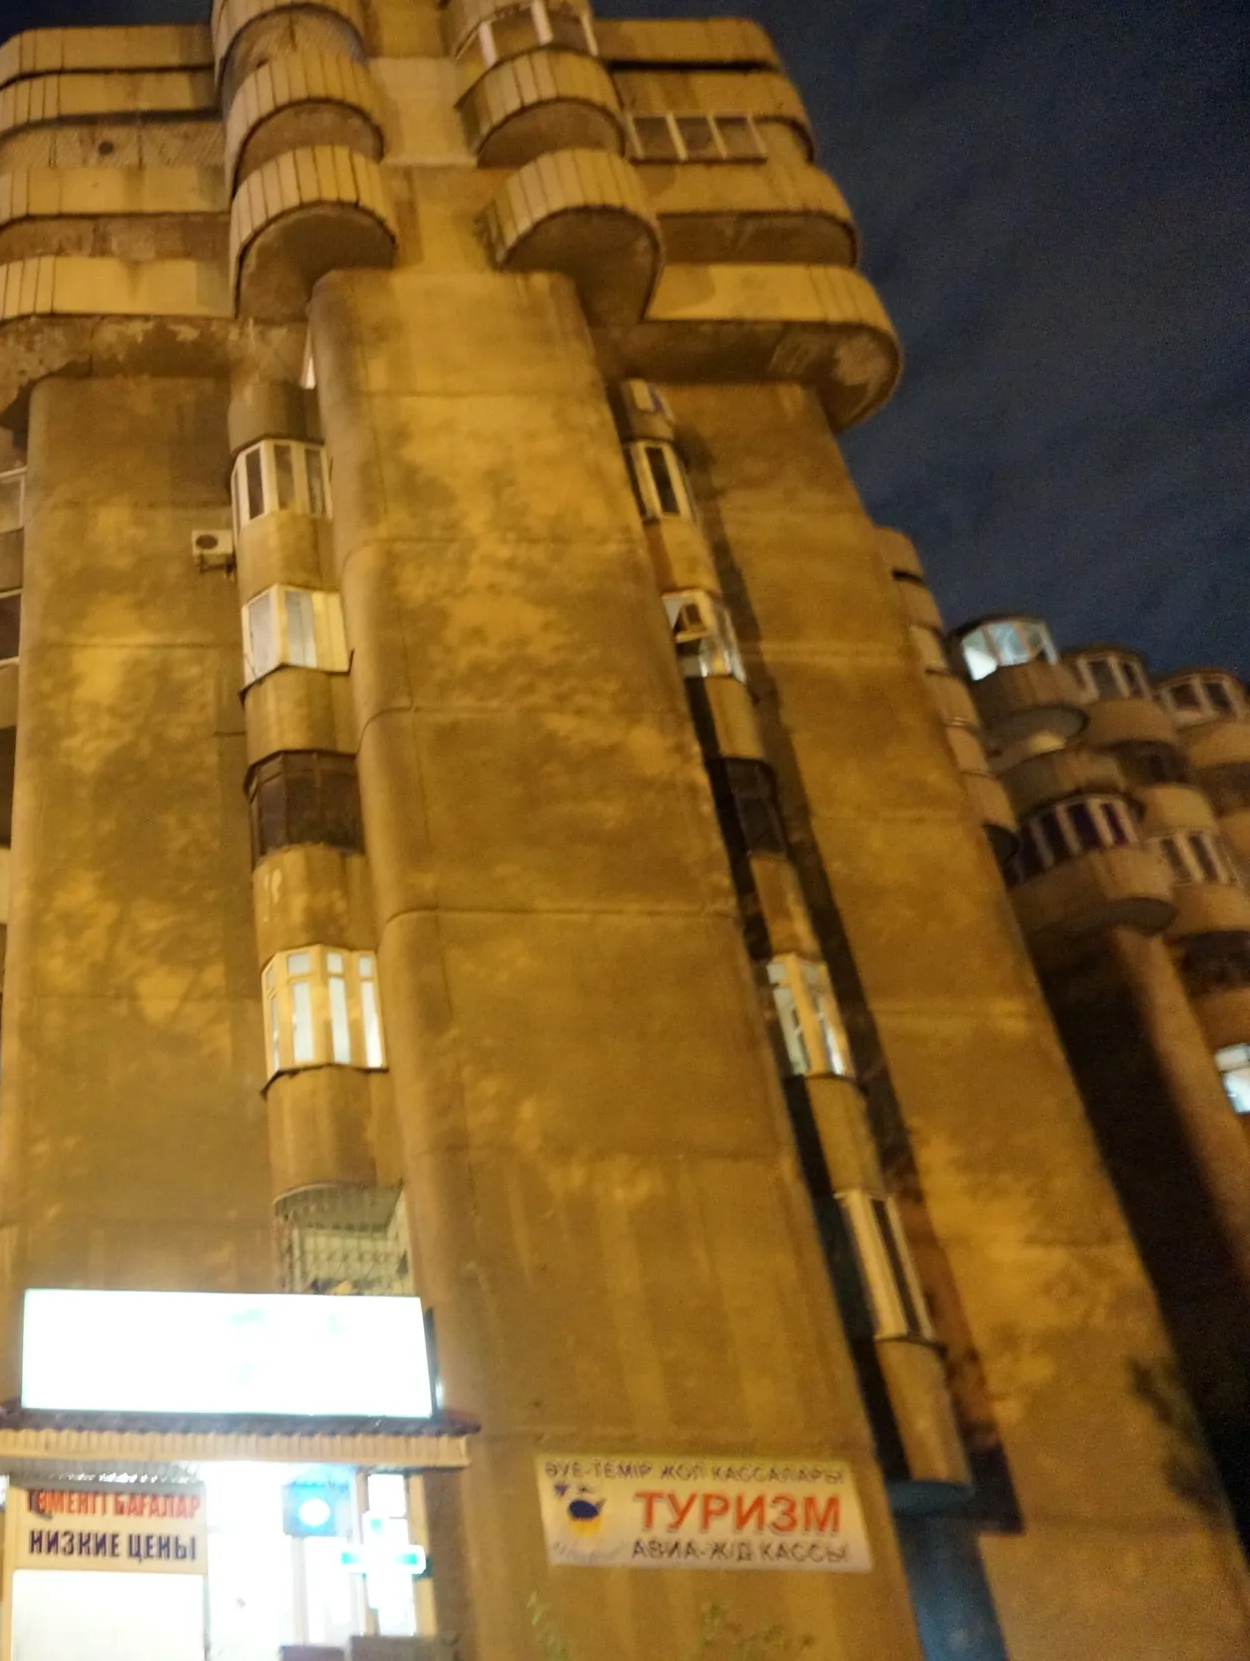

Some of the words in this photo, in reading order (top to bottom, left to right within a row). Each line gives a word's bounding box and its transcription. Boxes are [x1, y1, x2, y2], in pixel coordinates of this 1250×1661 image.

[634, 1489, 841, 1534] ТУРИЗМ
[28, 1530, 121, 1558] НИЗКИЕ
[127, 1533, 197, 1563] ЦЕНЫ
[760, 1541, 850, 1564] КАССЫ
